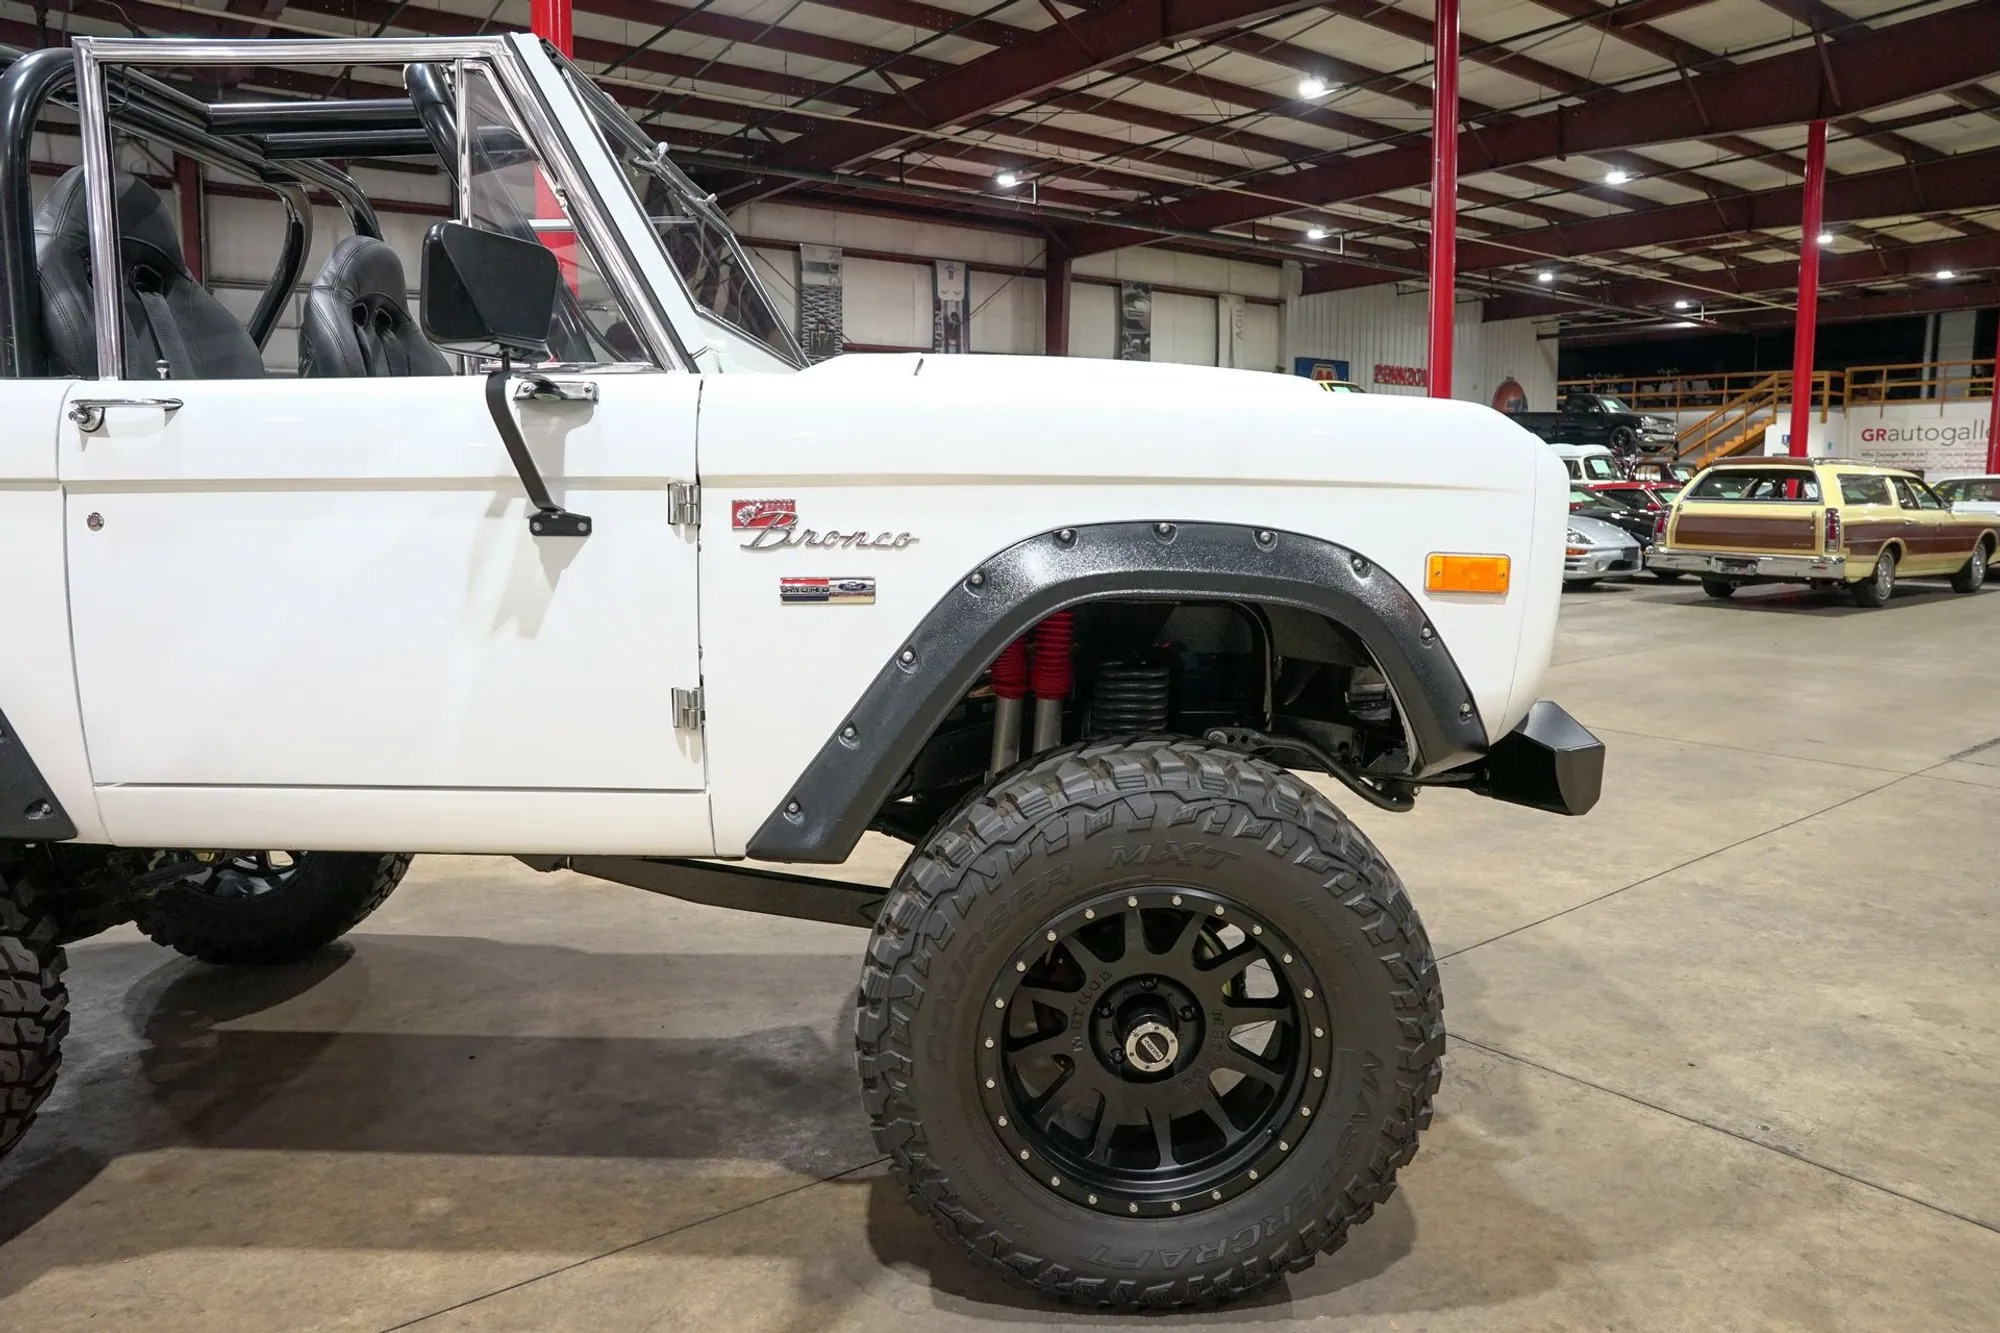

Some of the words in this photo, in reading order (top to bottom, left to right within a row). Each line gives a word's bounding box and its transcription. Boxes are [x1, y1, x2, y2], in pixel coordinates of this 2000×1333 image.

[740, 511, 920, 549] Bronco
[1104, 841, 1242, 869] MXT
[1073, 1050, 1385, 1270] MASTERCRAFT
